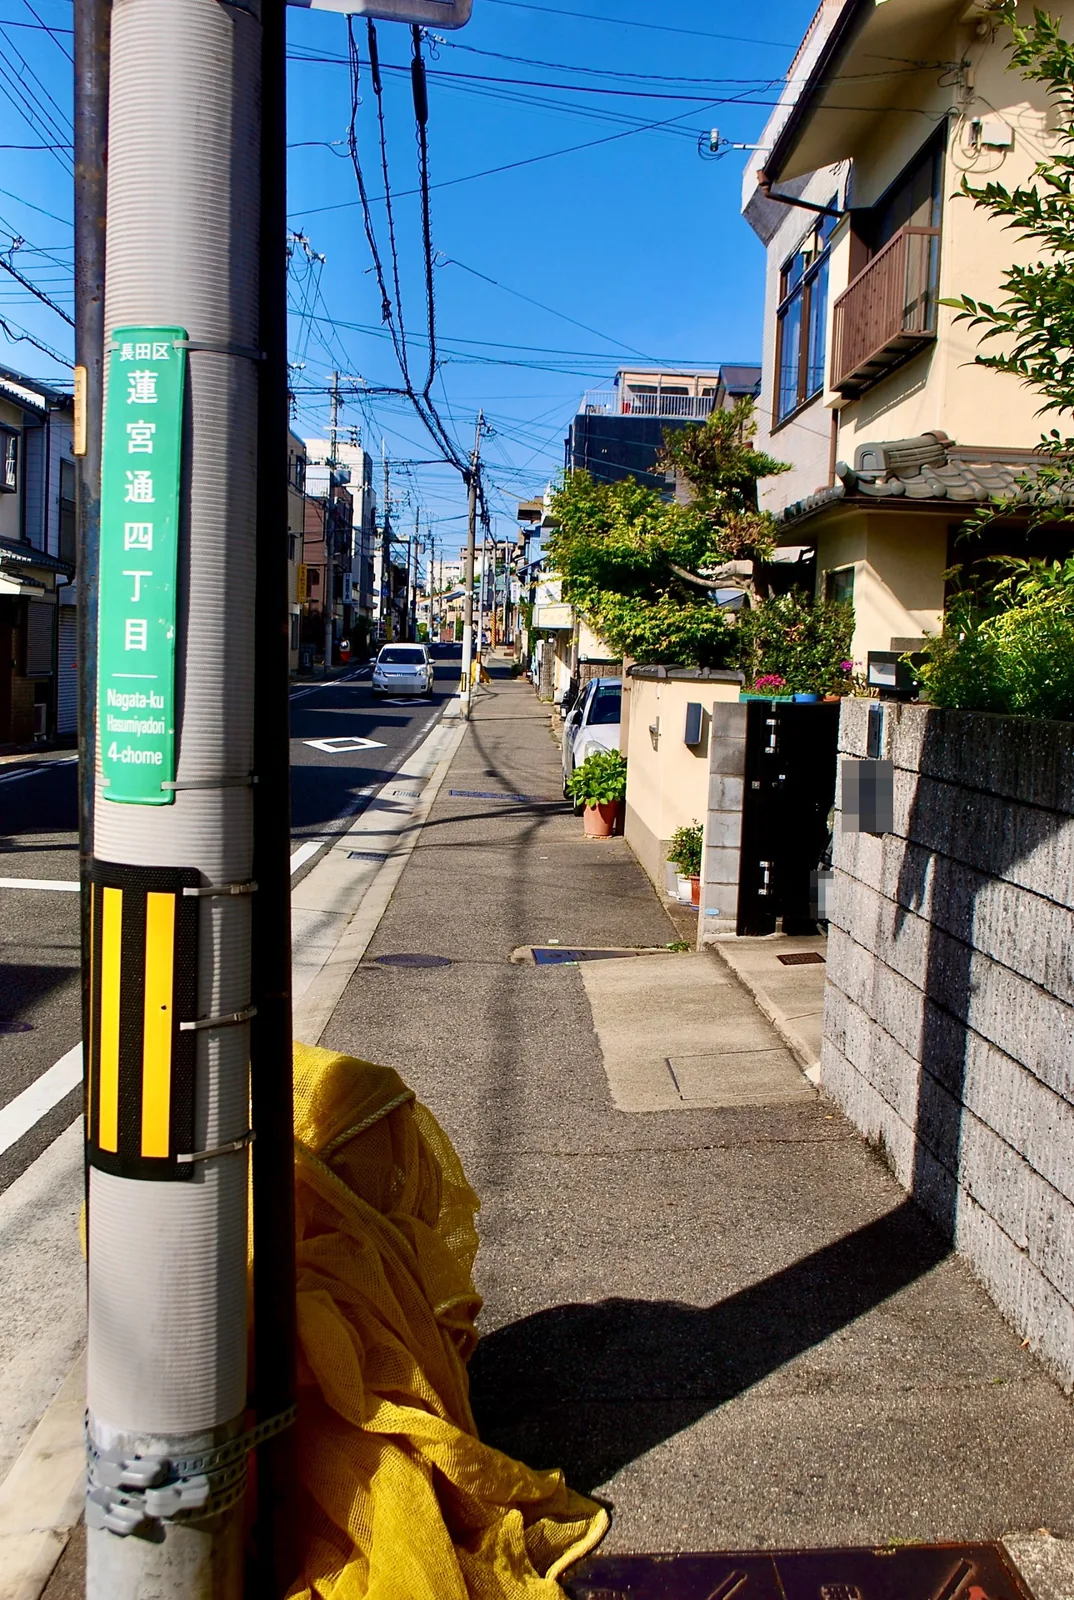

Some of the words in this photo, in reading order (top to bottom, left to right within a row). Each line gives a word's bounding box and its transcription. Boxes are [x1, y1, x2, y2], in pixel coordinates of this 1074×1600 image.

[120, 342, 170, 362] 長田区
[122, 369, 158, 652] 蓮宮通四丁目
[107, 688, 164, 711] Nagata-ku
[107, 714, 165, 737] Hasumiyadori
[107, 741, 163, 765] 4-chome
